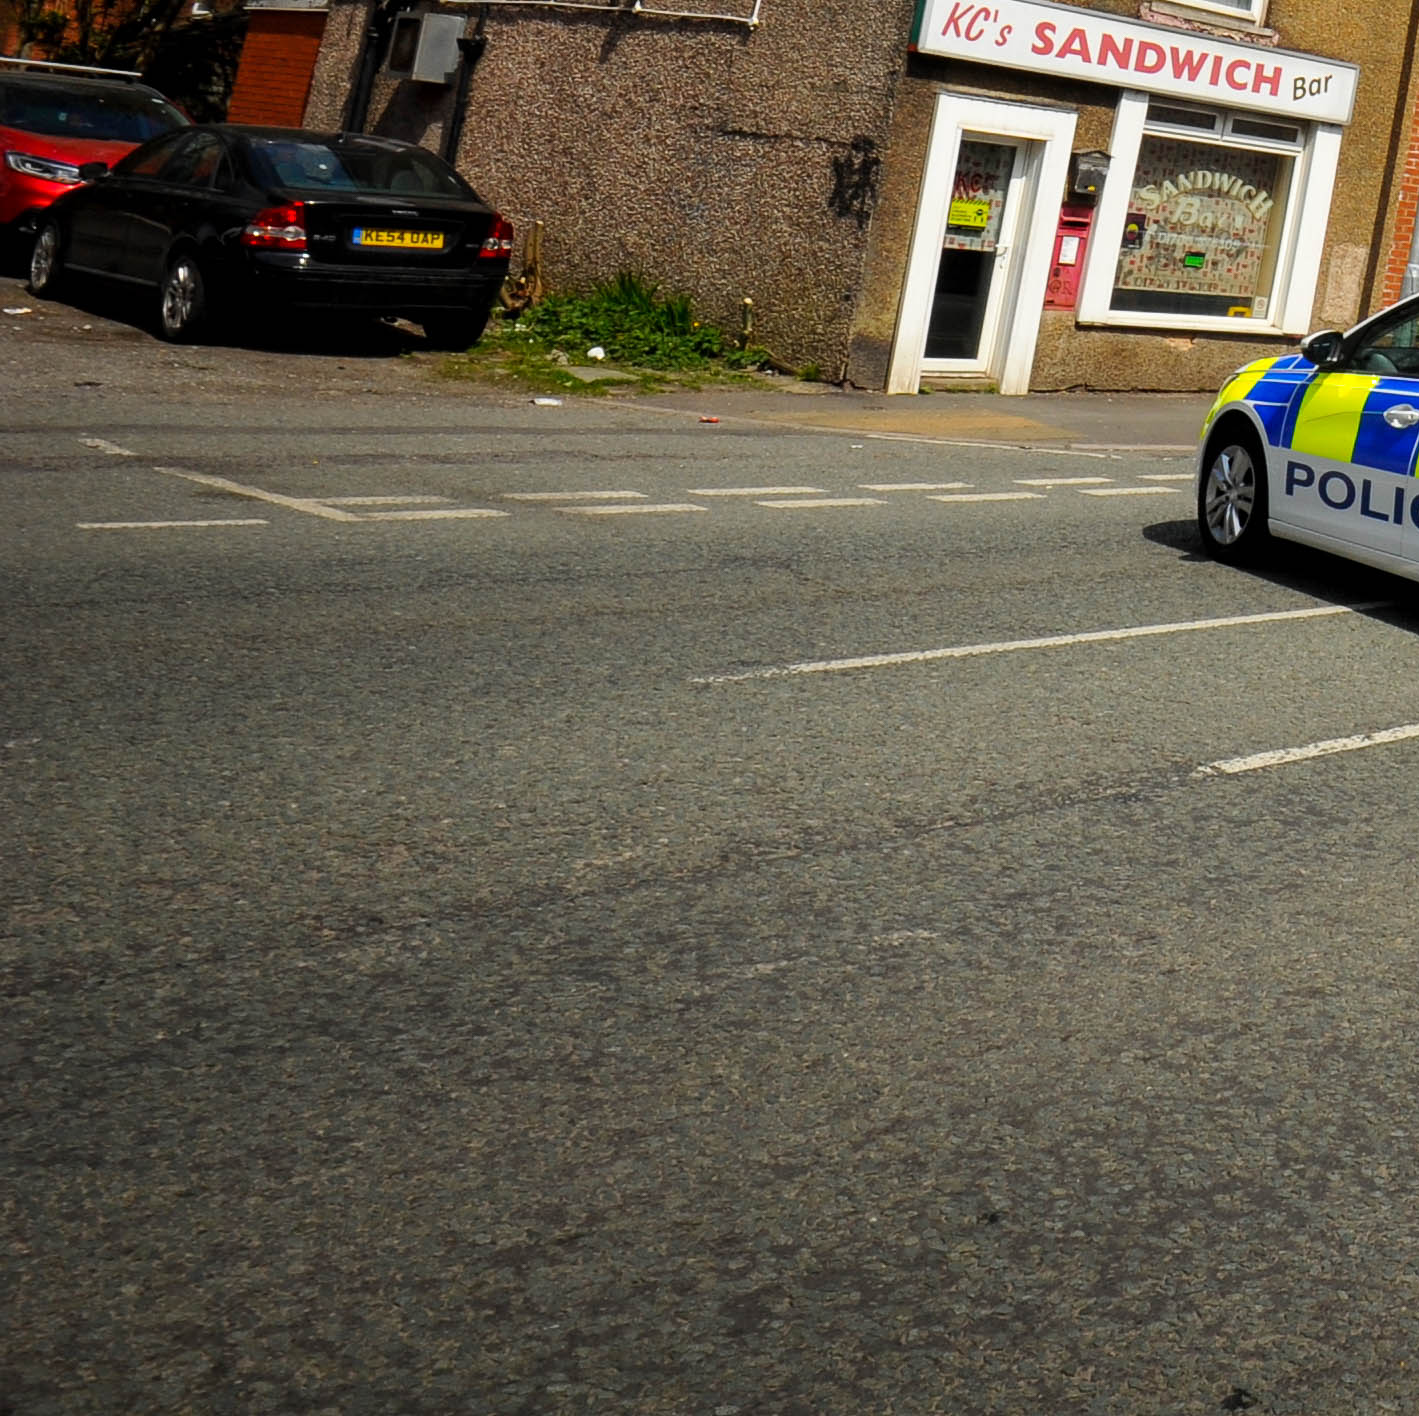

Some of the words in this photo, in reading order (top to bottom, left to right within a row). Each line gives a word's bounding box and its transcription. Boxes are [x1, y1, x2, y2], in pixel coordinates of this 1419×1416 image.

[941, 2, 1012, 47] KC's
[1031, 21, 1283, 97] SANDWICH
[1292, 72, 1333, 101] Bar
[1138, 170, 1274, 221] SANDWICH
[364, 229, 406, 244] KE54
